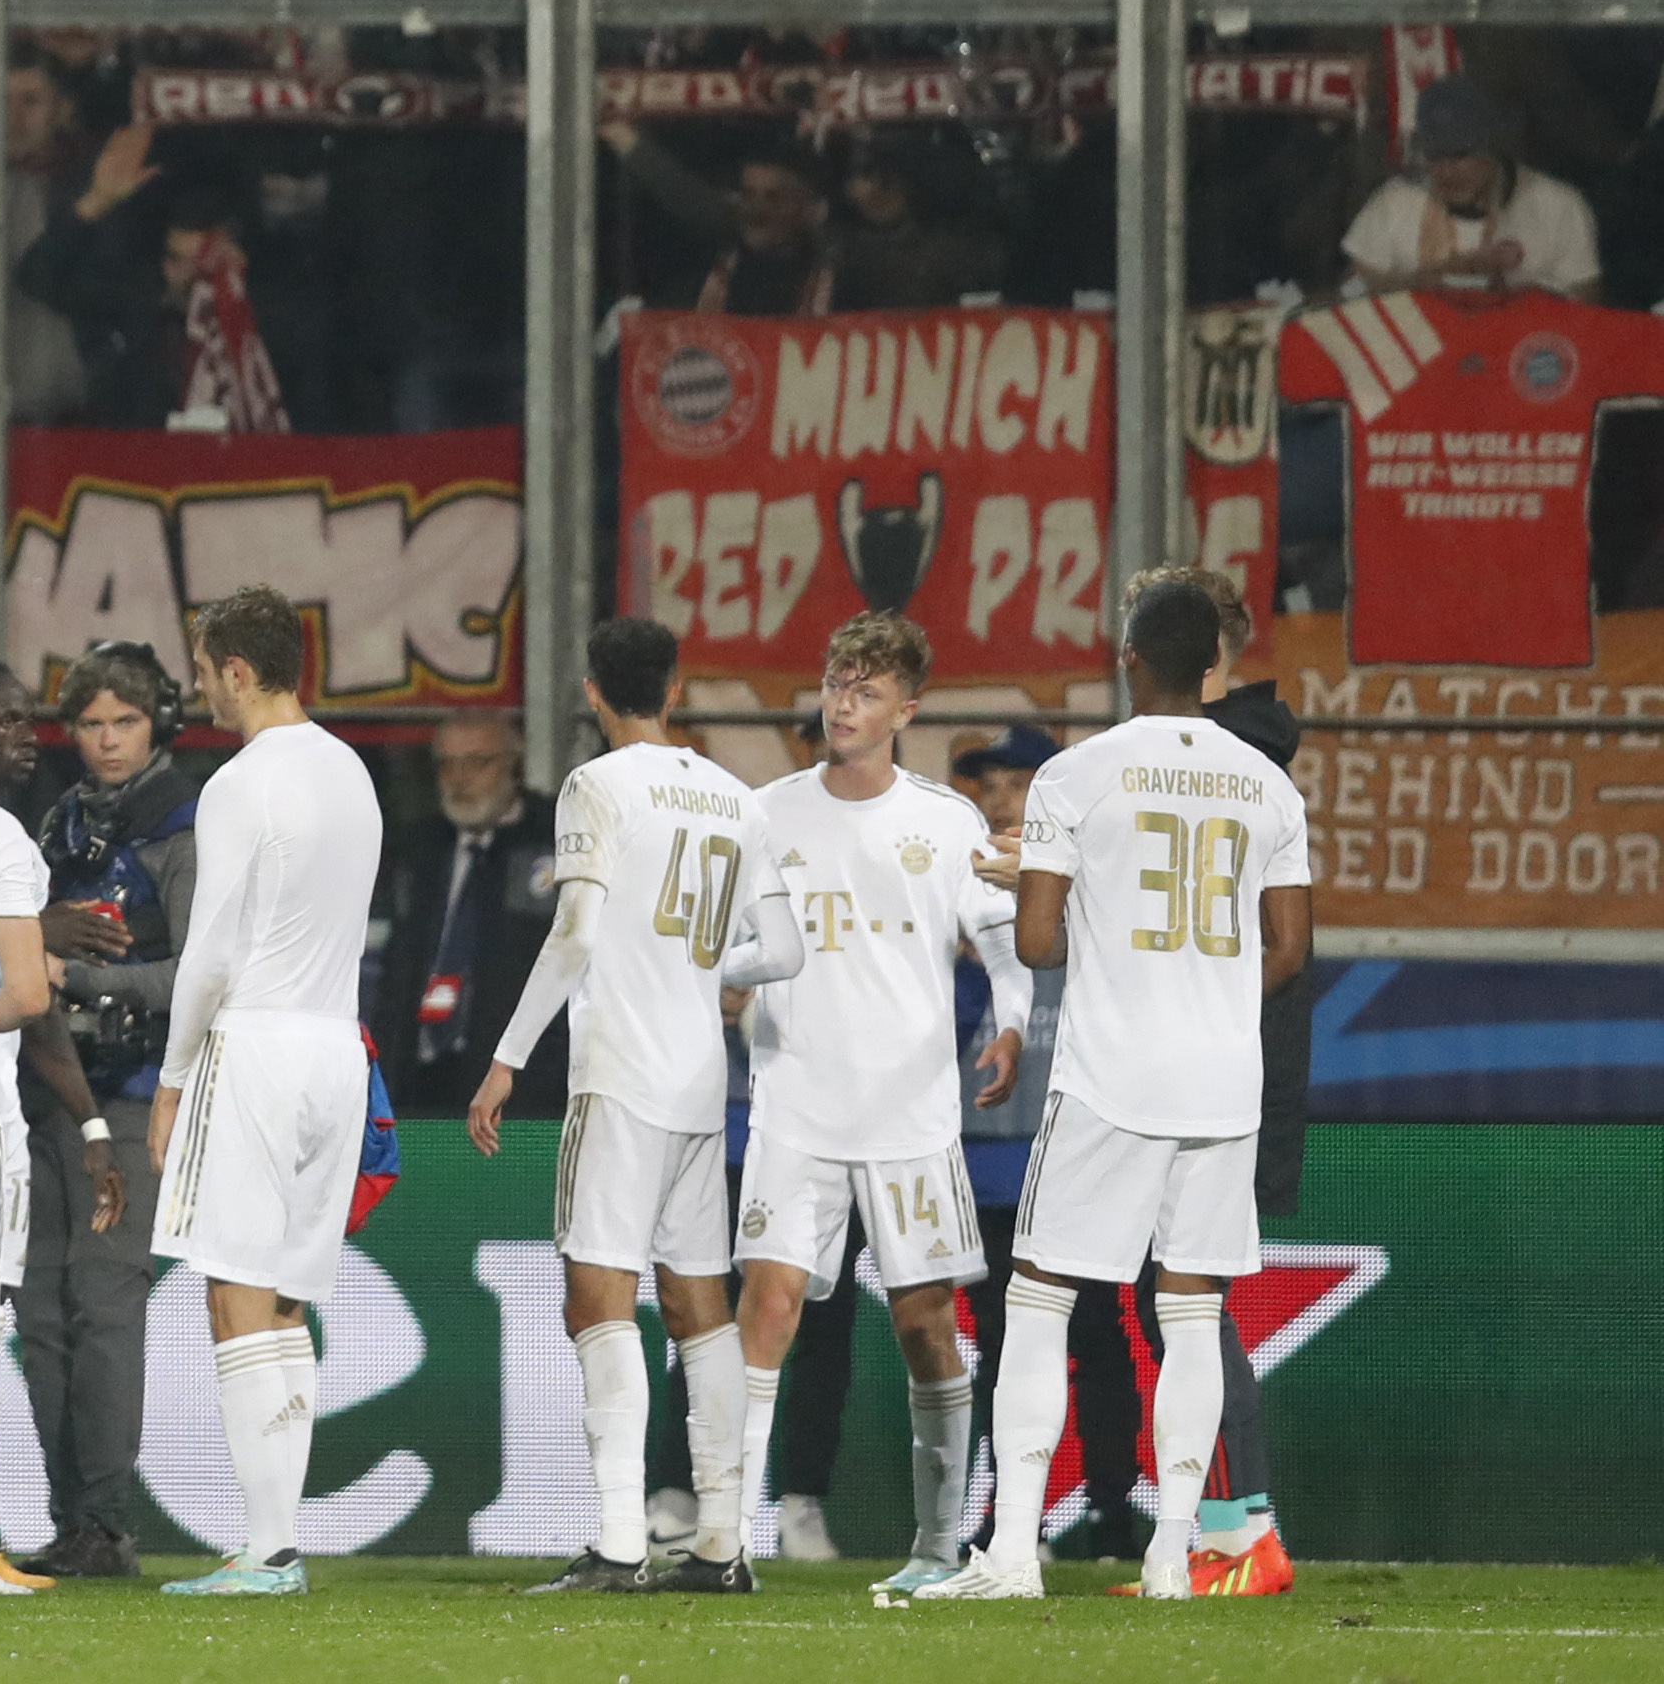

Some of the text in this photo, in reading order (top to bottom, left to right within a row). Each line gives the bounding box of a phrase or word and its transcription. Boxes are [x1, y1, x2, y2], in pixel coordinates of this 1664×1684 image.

[770, 316, 1100, 461] MUNICH
[1365, 431, 1585, 459] WIR WOLLEN
[643, 488, 825, 642] RED
[1122, 765, 1263, 806] GRAVENBERCH
[1291, 748, 1575, 821] BEHIND
[653, 827, 742, 969] 40
[1130, 811, 1250, 958] 38
[885, 1175, 941, 1236] 14
